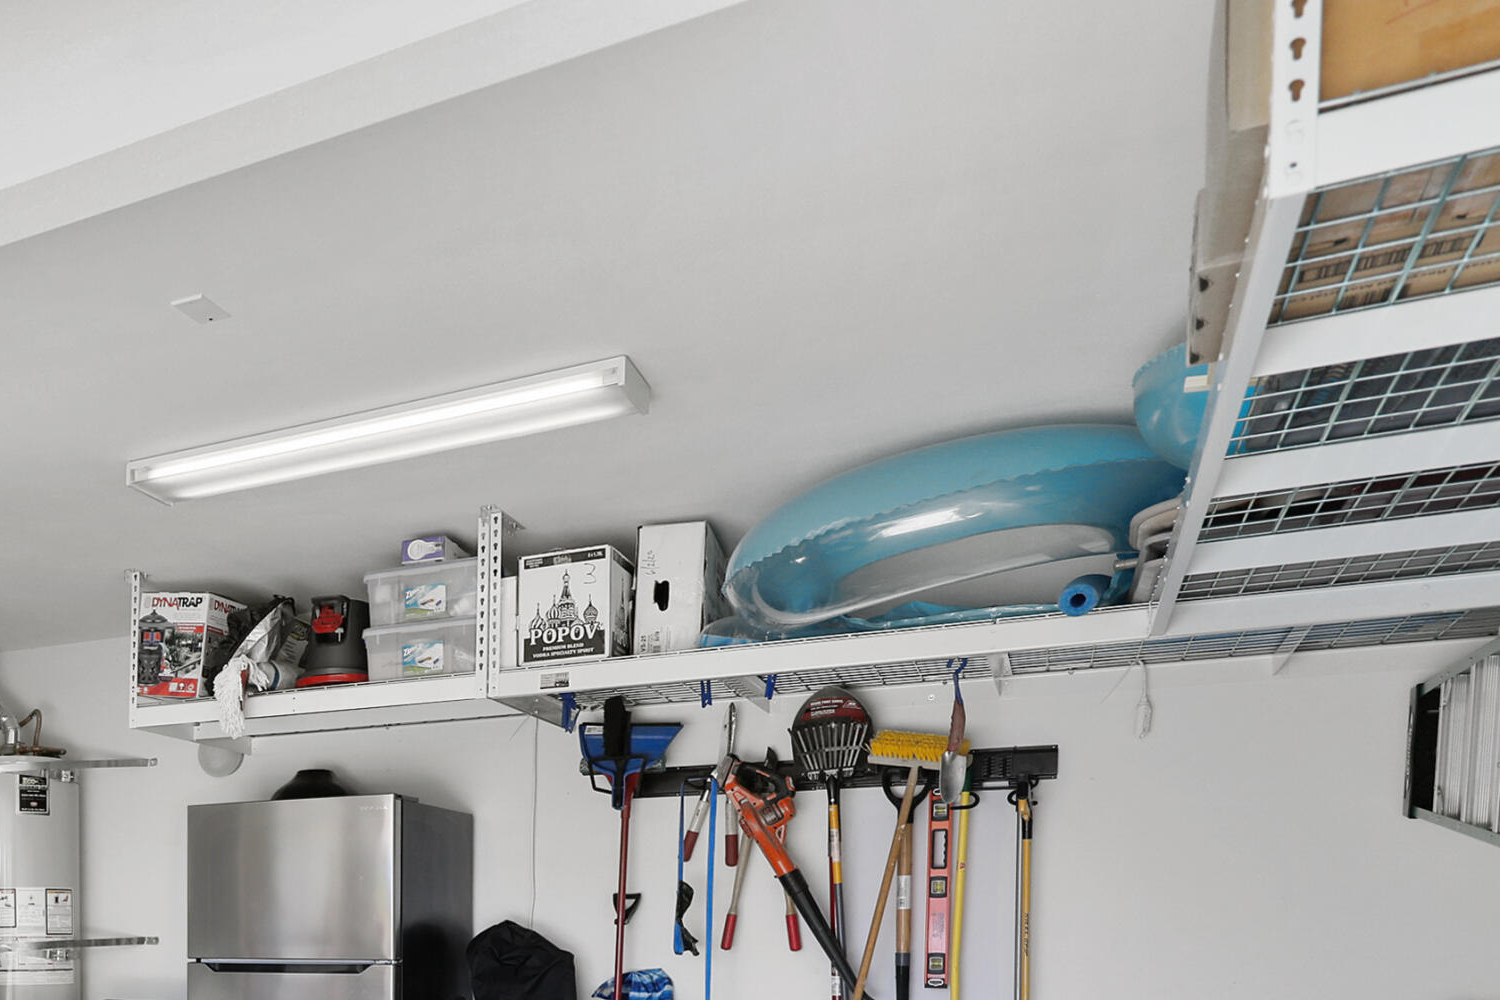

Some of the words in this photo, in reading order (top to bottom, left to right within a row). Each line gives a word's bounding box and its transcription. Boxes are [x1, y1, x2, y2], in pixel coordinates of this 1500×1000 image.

[583, 562, 597, 584] 3
[151, 596, 203, 610] DYNATRAP
[530, 622, 599, 646] POPOV
